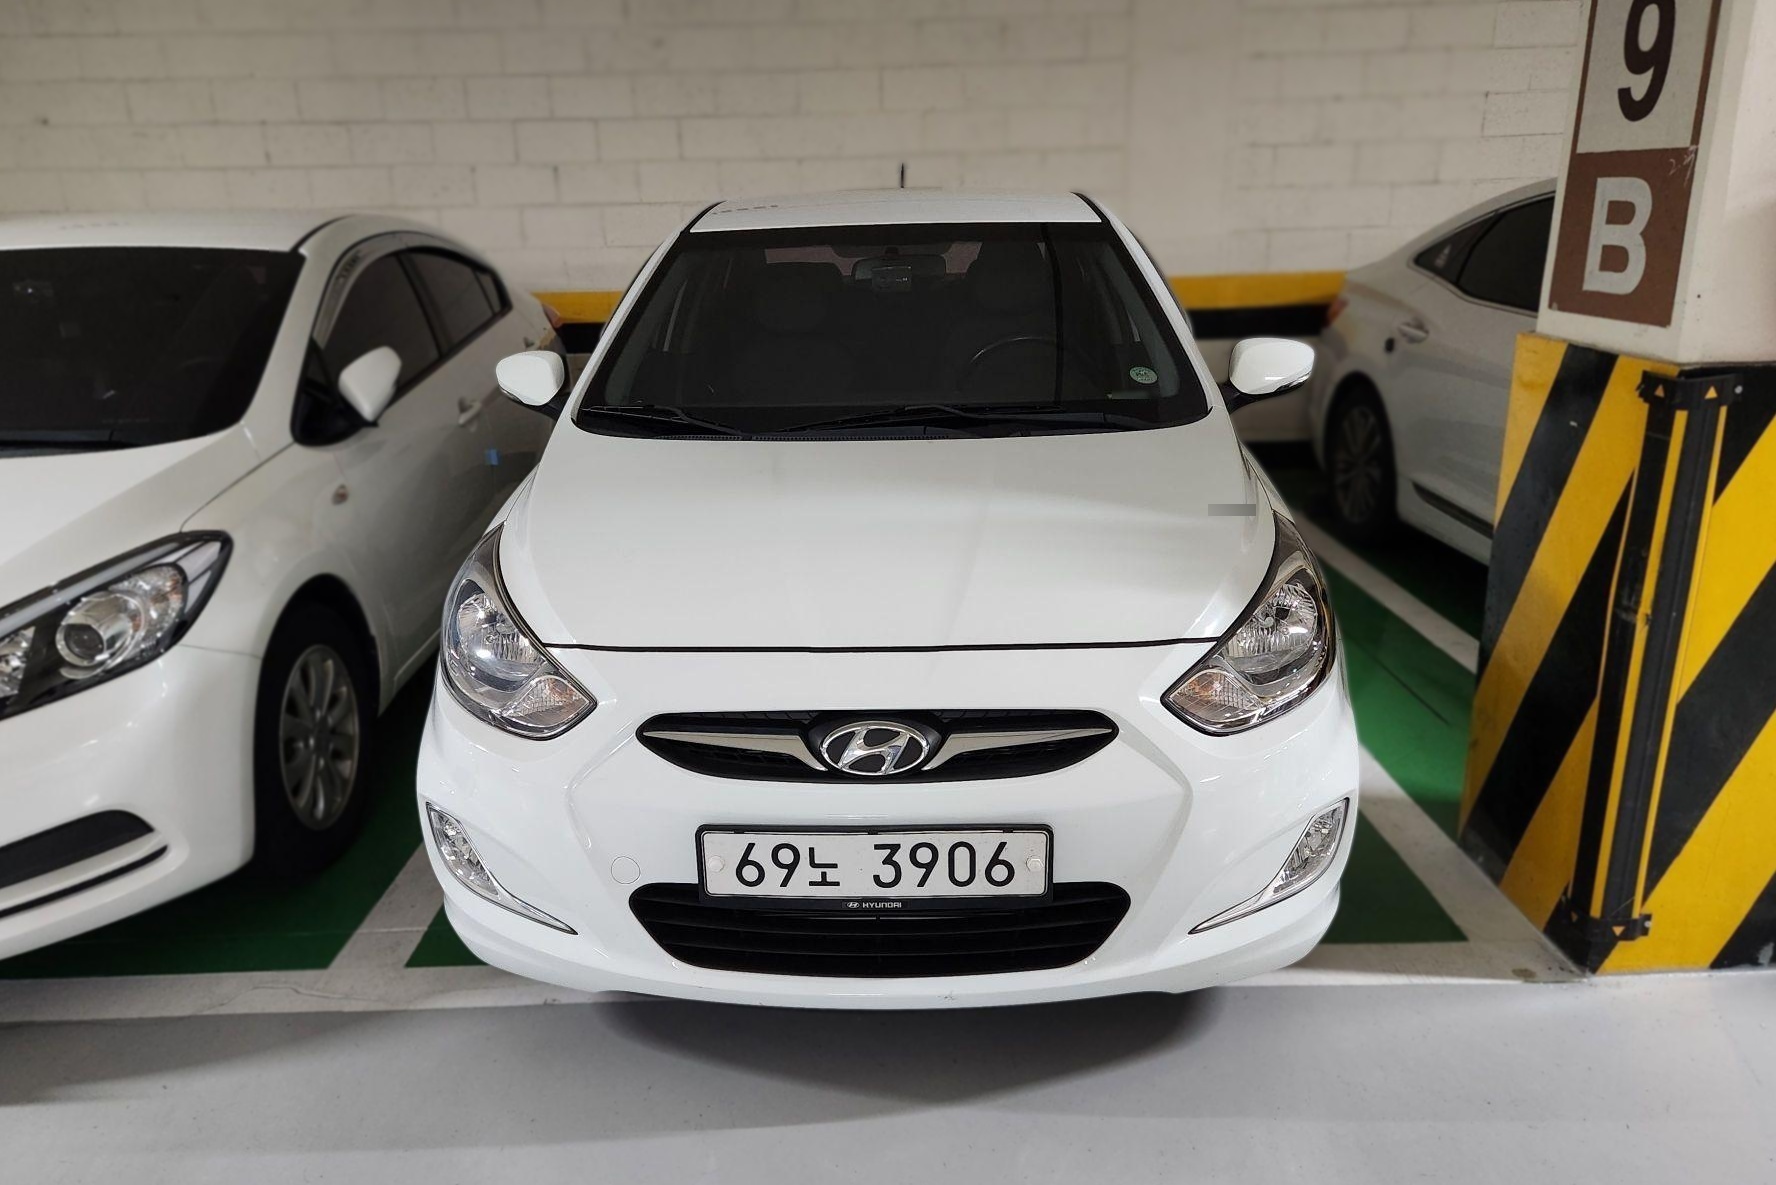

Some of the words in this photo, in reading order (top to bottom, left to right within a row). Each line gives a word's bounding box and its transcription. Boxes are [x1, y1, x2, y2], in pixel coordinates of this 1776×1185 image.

[1617, 0, 1676, 122] 9
[1582, 176, 1653, 296] B
[735, 842, 841, 888] 69노
[872, 841, 1016, 889] 3906
[862, 901, 902, 909] HYUNDAI
